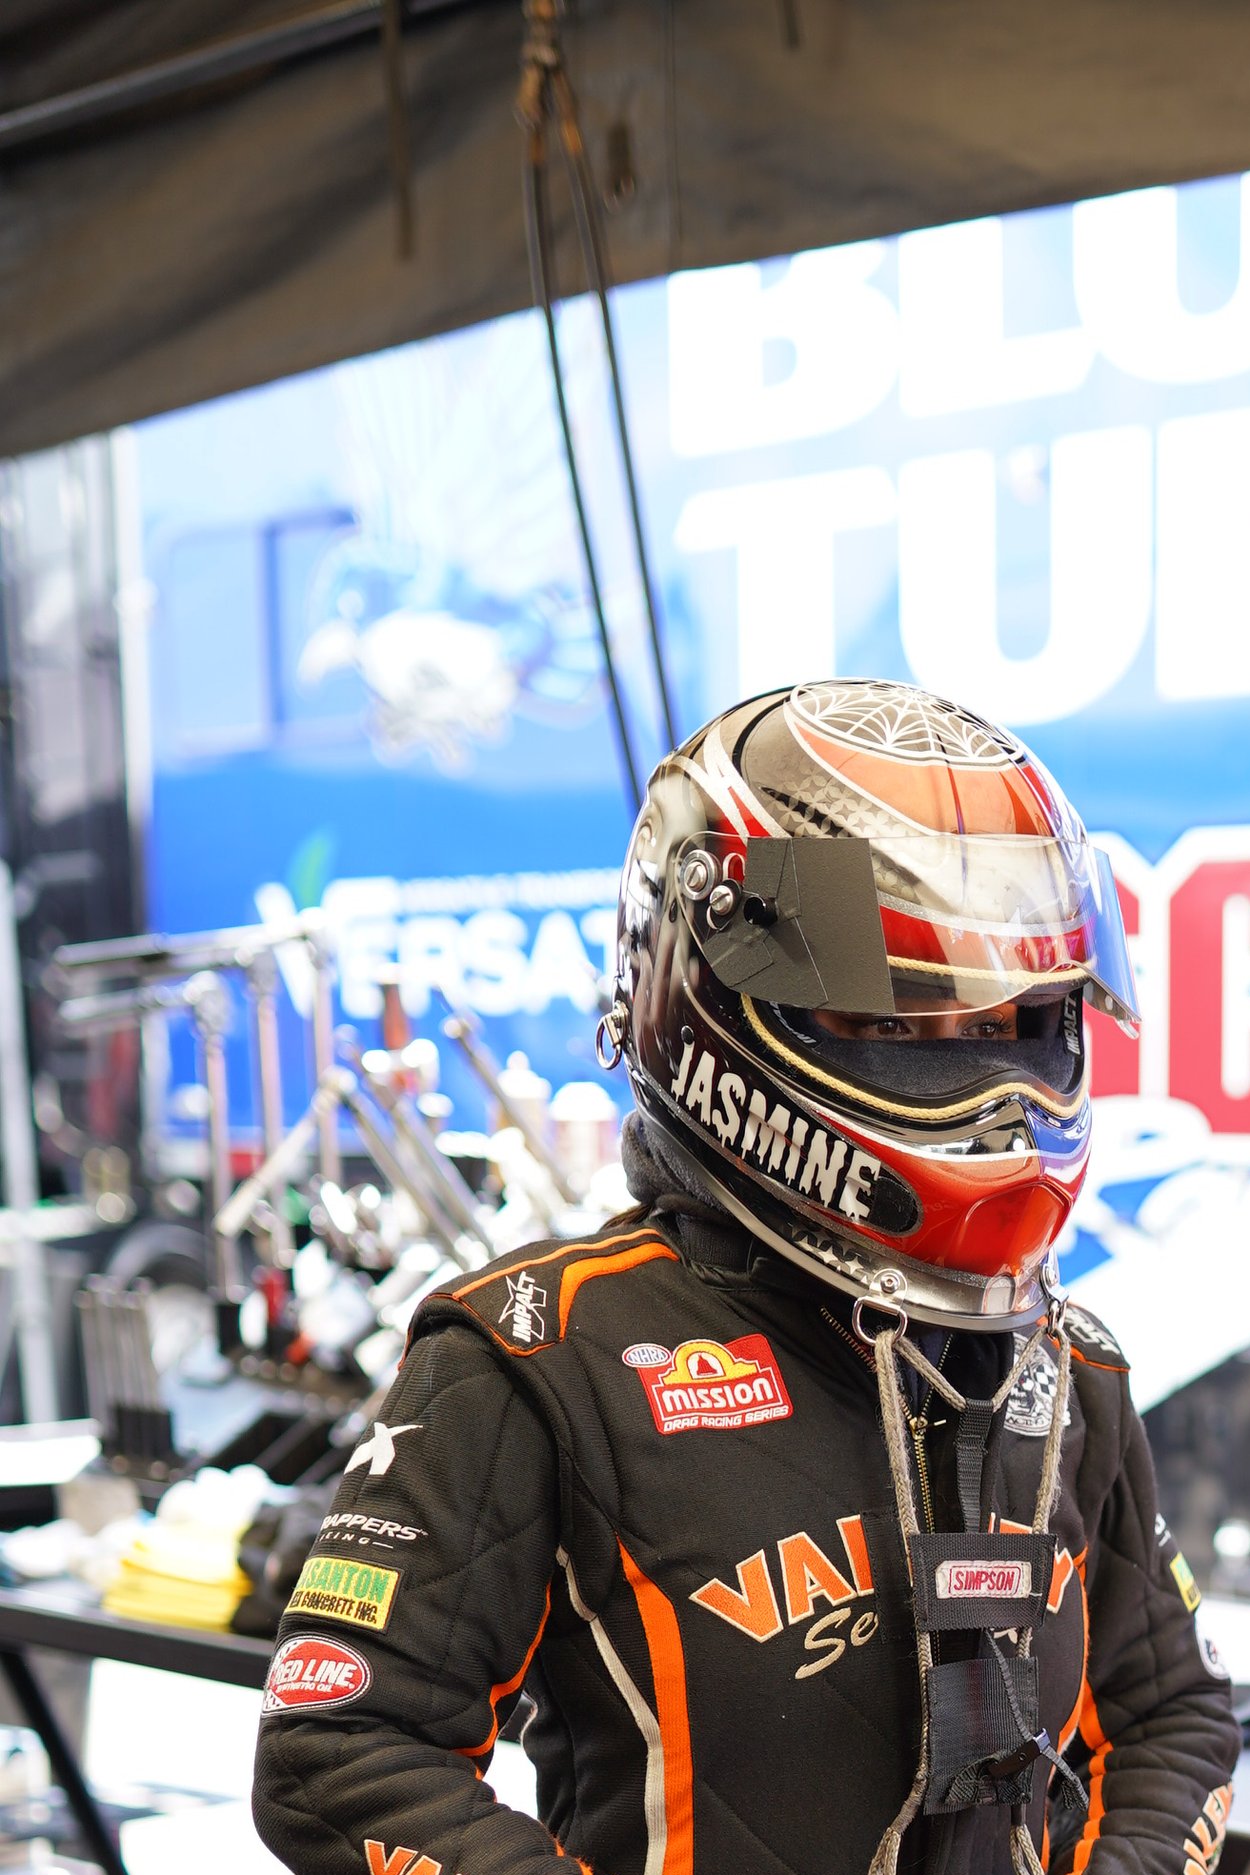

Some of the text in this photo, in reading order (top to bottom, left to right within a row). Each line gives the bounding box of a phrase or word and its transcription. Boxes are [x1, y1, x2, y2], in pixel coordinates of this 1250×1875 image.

[671, 1044, 881, 1224] JASMINE
[511, 1270, 537, 1343] IMPACT
[627, 1345, 666, 1363] NHRA
[663, 1405, 789, 1432] DRAG RACING SERIES
[953, 1570, 1016, 1592] SIMPSON
[274, 1658, 358, 1688] RED LINE
